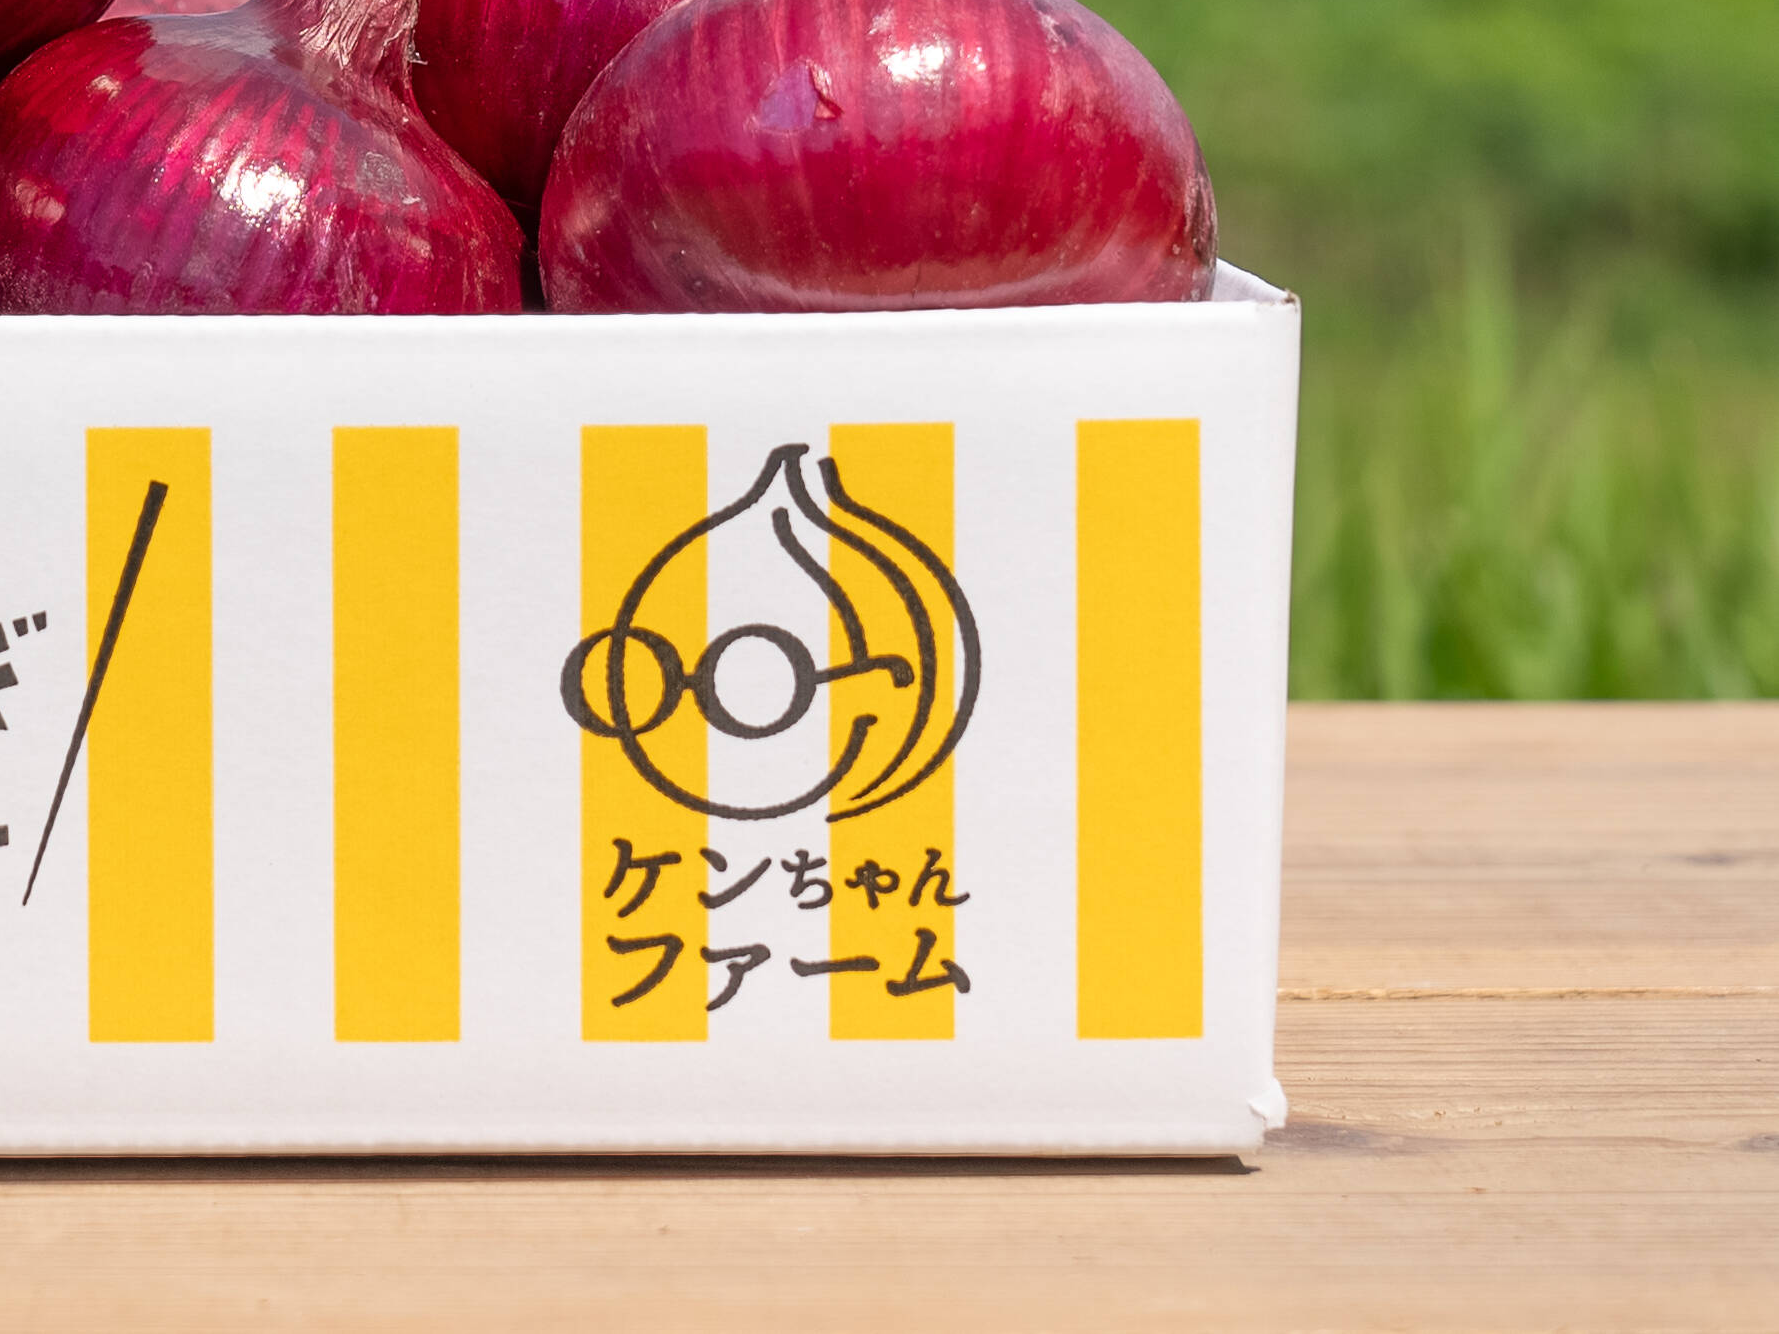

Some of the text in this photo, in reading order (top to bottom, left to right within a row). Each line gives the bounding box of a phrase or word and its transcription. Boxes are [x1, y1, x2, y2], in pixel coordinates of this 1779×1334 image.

[604, 838, 971, 919] ケンちゃん
[606, 928, 972, 1012] ファーム
